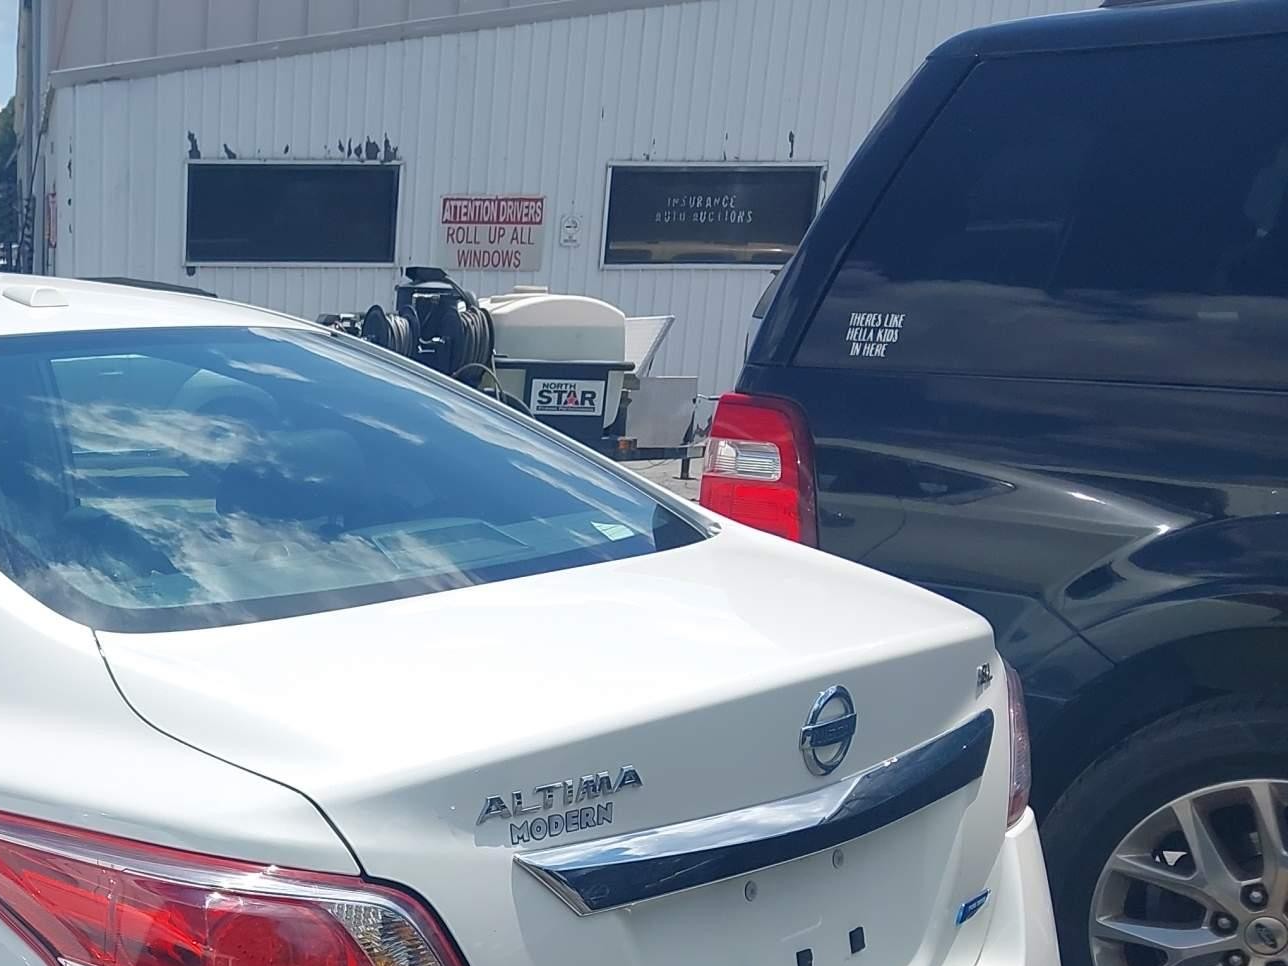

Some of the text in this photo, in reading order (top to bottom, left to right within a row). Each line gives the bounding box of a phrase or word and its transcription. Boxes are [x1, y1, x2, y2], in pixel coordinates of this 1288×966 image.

[443, 200, 543, 222] ATTENTION DRIVERS
[446, 226, 535, 245] ROLL UP ALL
[457, 249, 521, 268] WINDOWS
[849, 312, 906, 328] THERES LIKE
[845, 327, 899, 343] HELLA KIDS
[849, 342, 889, 357] IN HERE
[542, 382, 577, 390] NORTH
[537, 389, 597, 406] STAR
[476, 764, 644, 826] ALTIMA
[510, 802, 614, 845] MODERN
